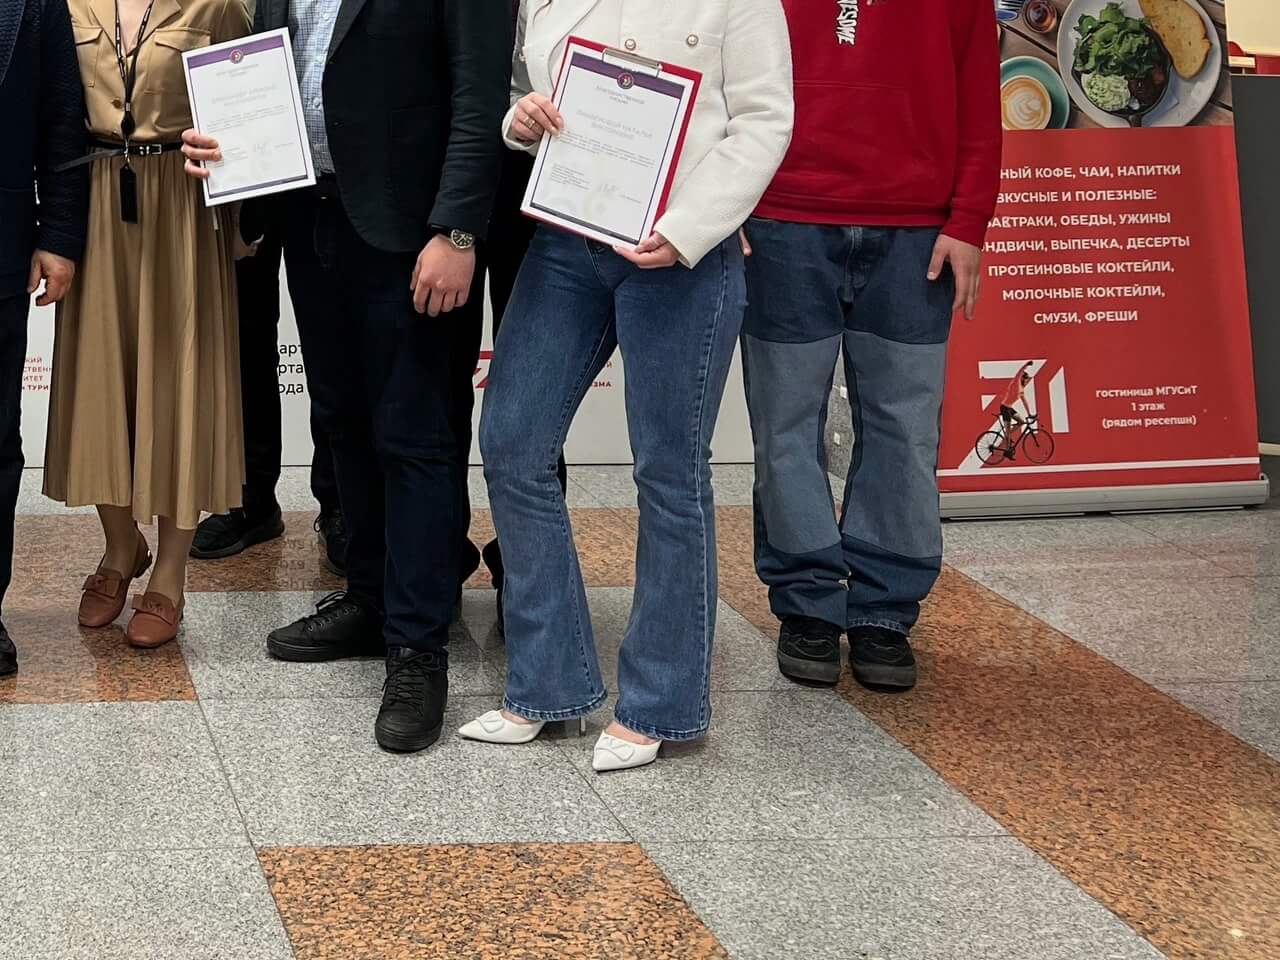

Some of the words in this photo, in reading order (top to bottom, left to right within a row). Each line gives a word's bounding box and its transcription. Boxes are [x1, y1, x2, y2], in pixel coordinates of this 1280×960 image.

[1035, 167, 1076, 179] КОФЕ,
[1118, 164, 1180, 176] НАПИТКИ
[1062, 191, 1071, 202] И
[1076, 189, 1157, 201] ПОЛЕЗНЫЕ:
[988, 216, 1057, 228] АВТРАКИ,
[1060, 214, 1116, 226] ОБЕДЫ,
[1119, 213, 1171, 224] УЖИНЫ
[982, 240, 1048, 253] НДВИЧИ,
[1051, 238, 1123, 251] ВЫПЕЧКА,
[1127, 236, 1190, 249] ДЕСЕРТЫ
[988, 264, 1093, 276] ПРОТЕИНОВЫЕ
[1097, 259, 1175, 273] КОКТЕЙЛИ,
[1002, 288, 1084, 300] МОЛОЧНЫЕ
[1088, 284, 1165, 298] КОКТЕЙЛИ,
[1034, 312, 1082, 324] СМУЗИ,
[1084, 310, 1138, 322] ФРЕШИ
[1096, 388, 1153, 398] гостиница
[1156, 385, 1198, 396] МГУСиТ
[1138, 403, 1166, 411] этаж
[1102, 418, 1142, 429] (рядом
[1144, 415, 1196, 428] ресепшн)
